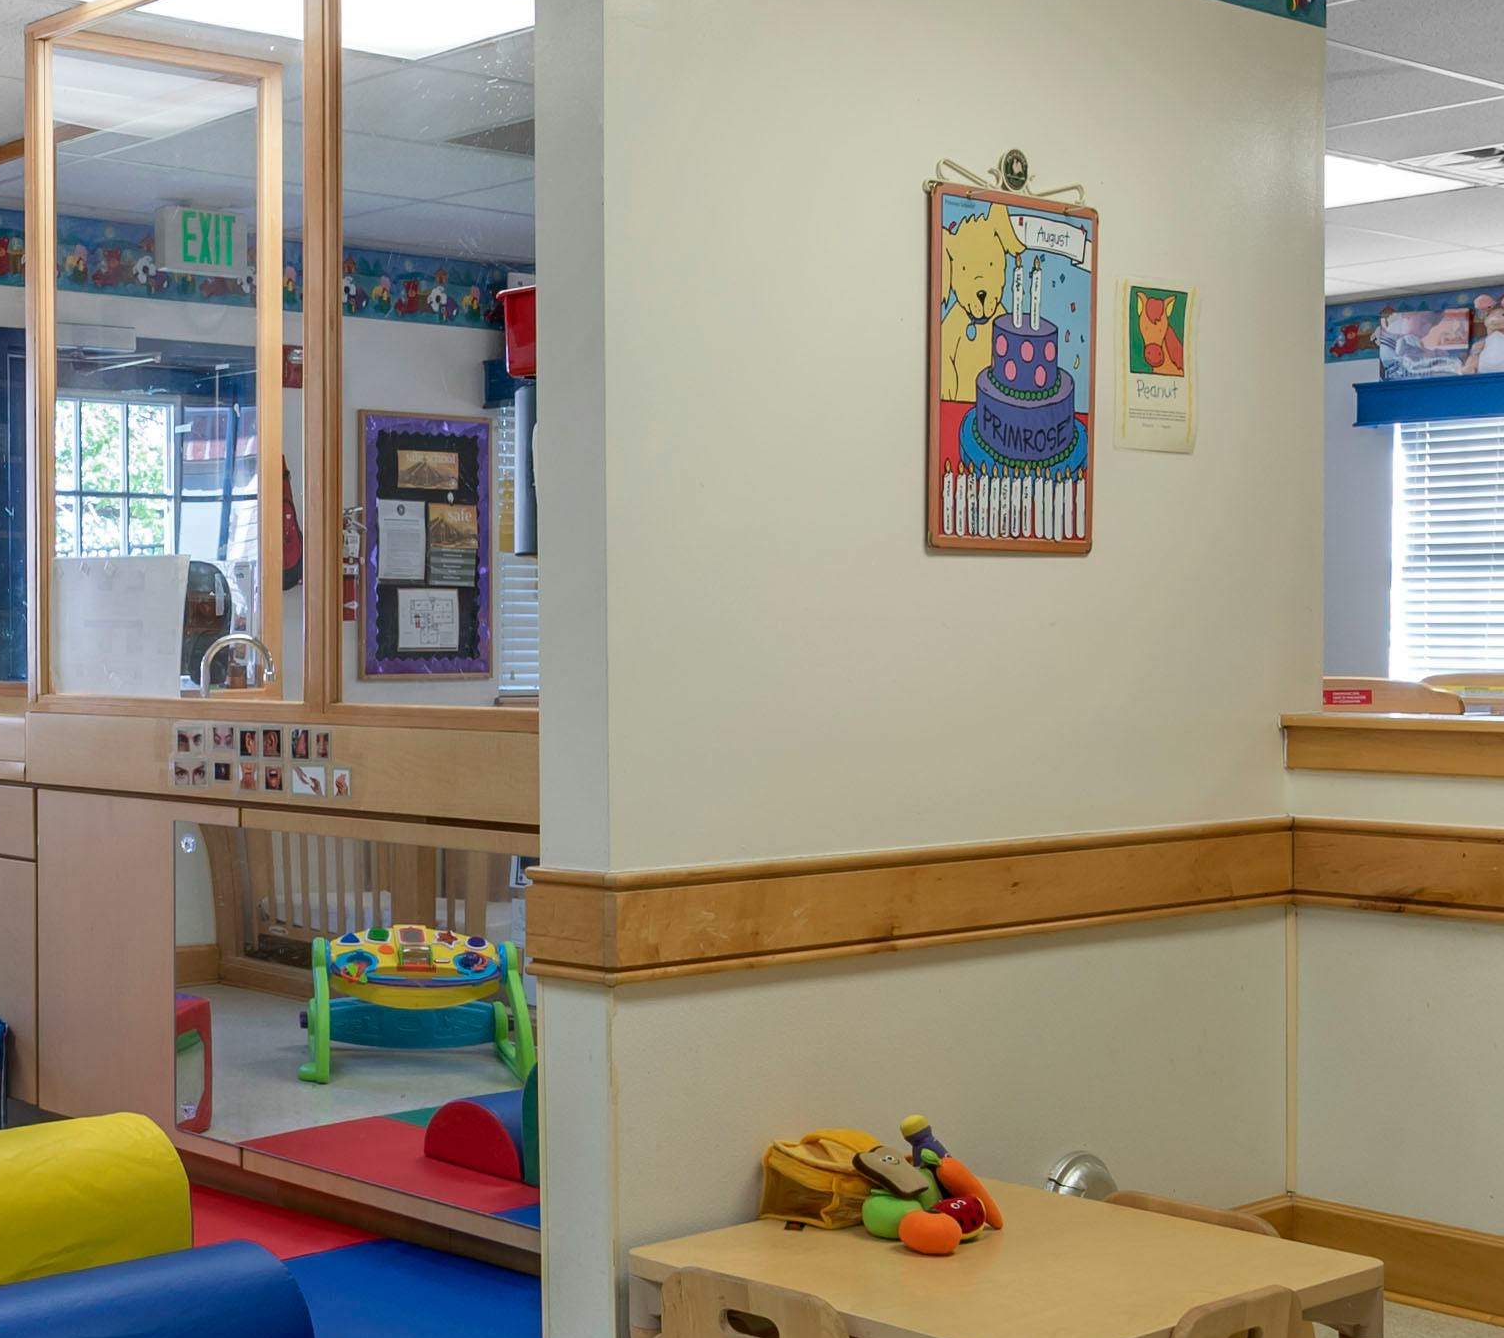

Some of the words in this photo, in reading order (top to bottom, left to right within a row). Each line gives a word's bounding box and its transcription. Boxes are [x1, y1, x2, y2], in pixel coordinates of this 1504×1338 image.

[182, 212, 236, 266] EXIT
[1036, 226, 1071, 247] August
[1137, 379, 1178, 399] Peanut
[983, 405, 1067, 453] PRIMROSE
[447, 510, 473, 523] safe
